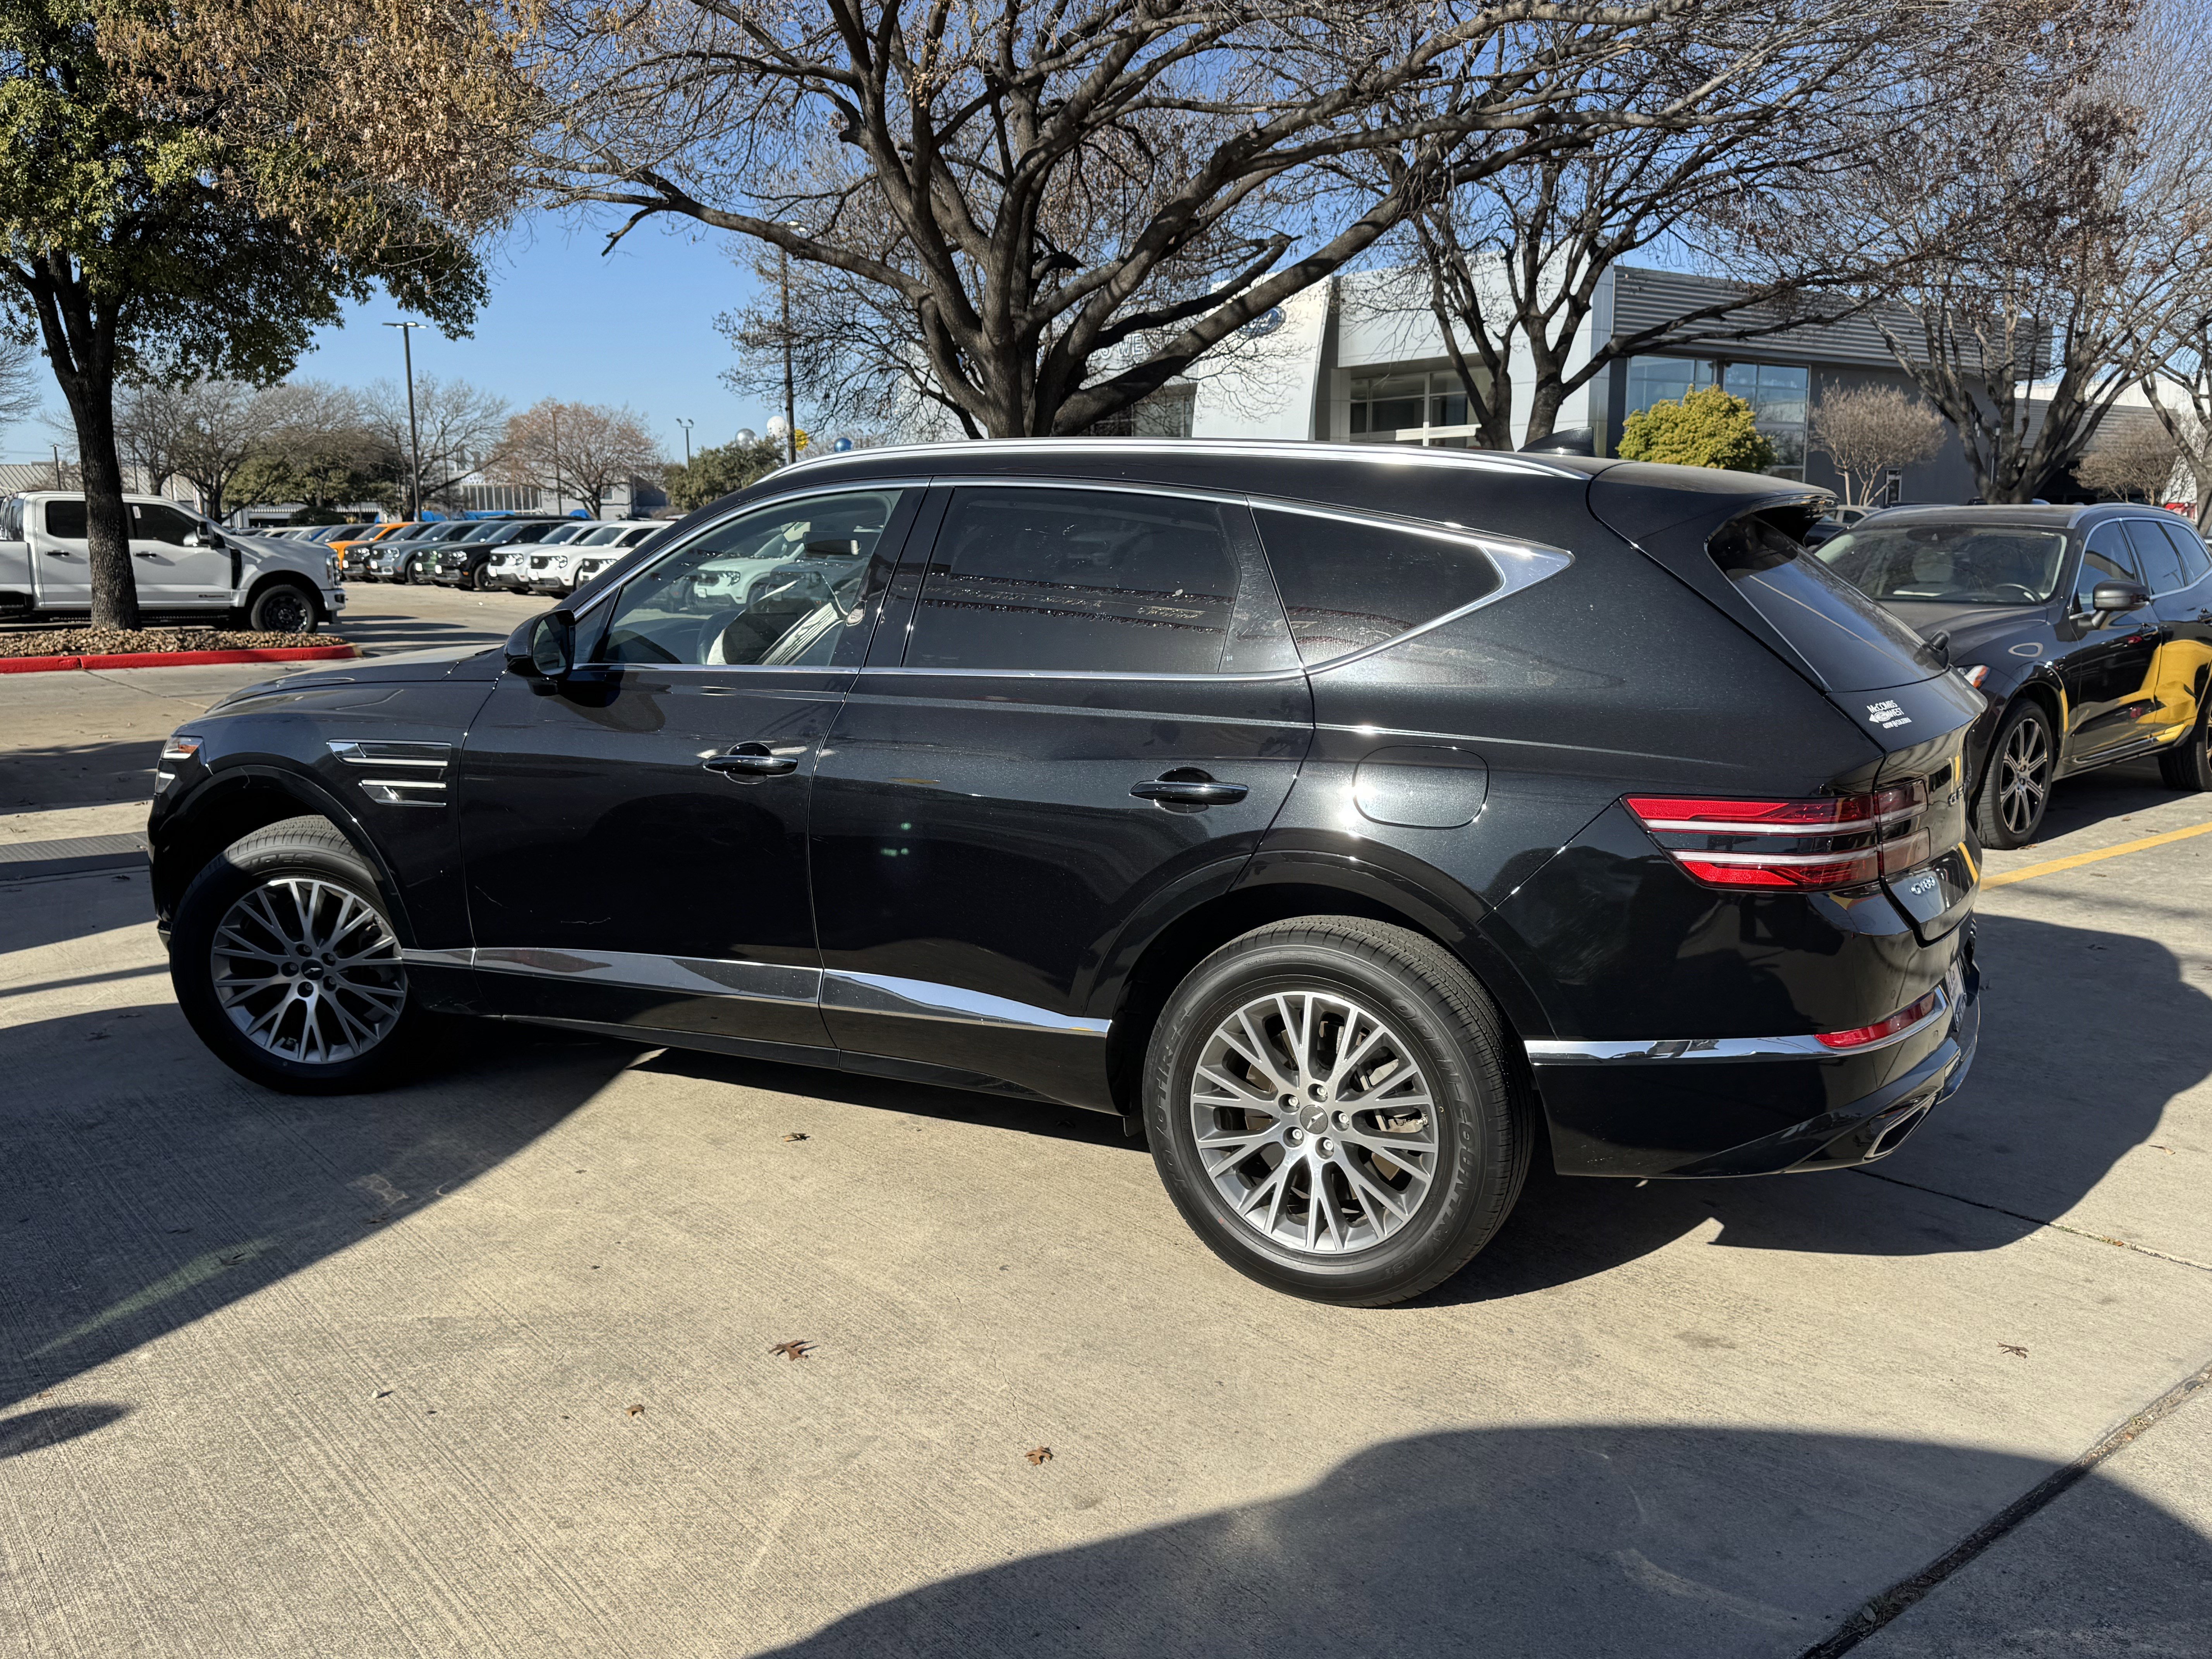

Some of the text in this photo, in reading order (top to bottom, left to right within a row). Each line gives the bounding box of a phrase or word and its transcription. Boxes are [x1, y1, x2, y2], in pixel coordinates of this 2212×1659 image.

[1867, 700, 1898, 713] McCOMBS
[1886, 708, 1904, 717] WEST
[1390, 998, 1460, 1084] OPEN
[1425, 1099, 1476, 1257] COUNTRY
